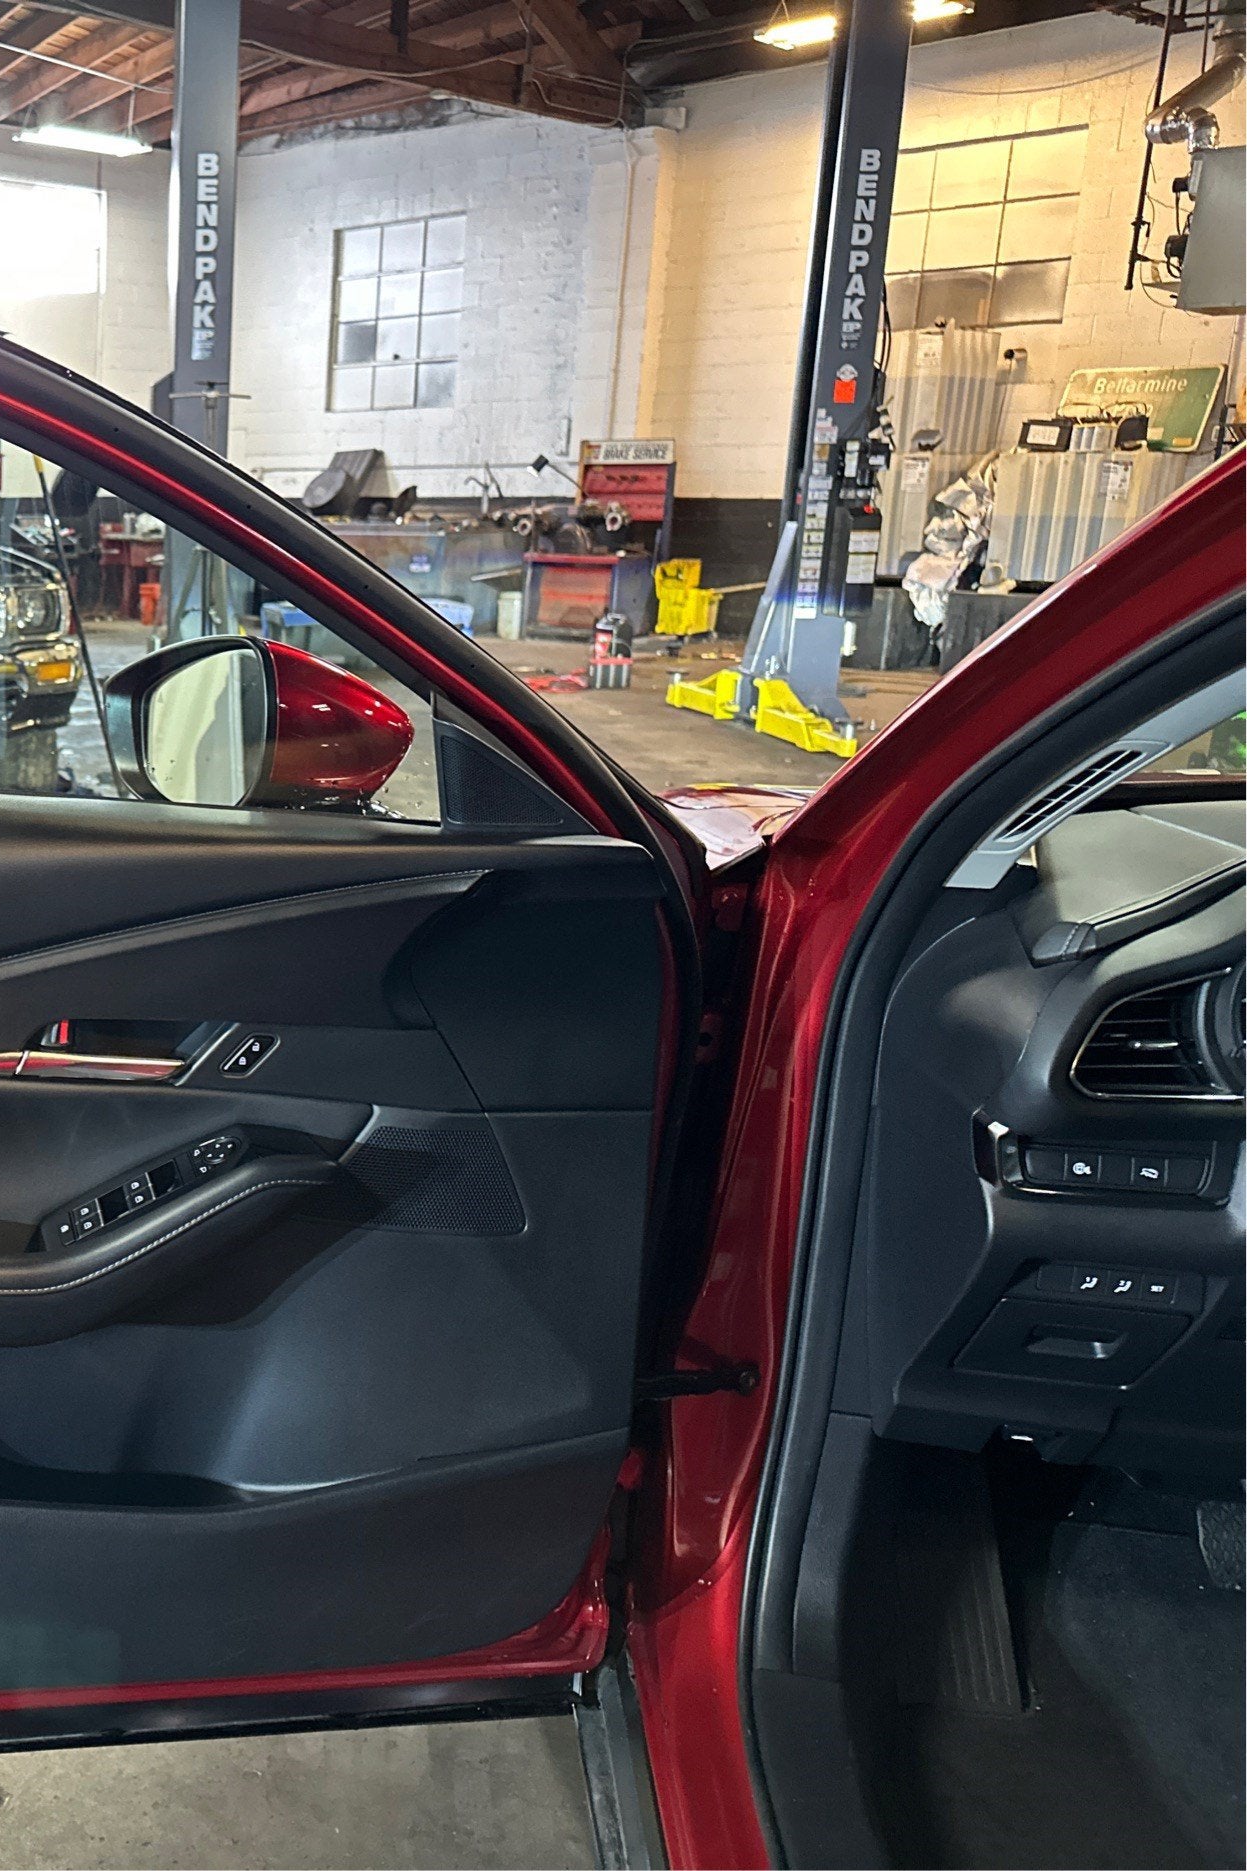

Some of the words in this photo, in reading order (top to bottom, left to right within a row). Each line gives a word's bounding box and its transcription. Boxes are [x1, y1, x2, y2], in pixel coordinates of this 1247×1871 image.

[192, 153, 219, 328] BENDPAK
[842, 149, 881, 320] BENDPAK
[1093, 375, 1188, 394] Bellarmine
[632, 448, 666, 460] SERVICE
